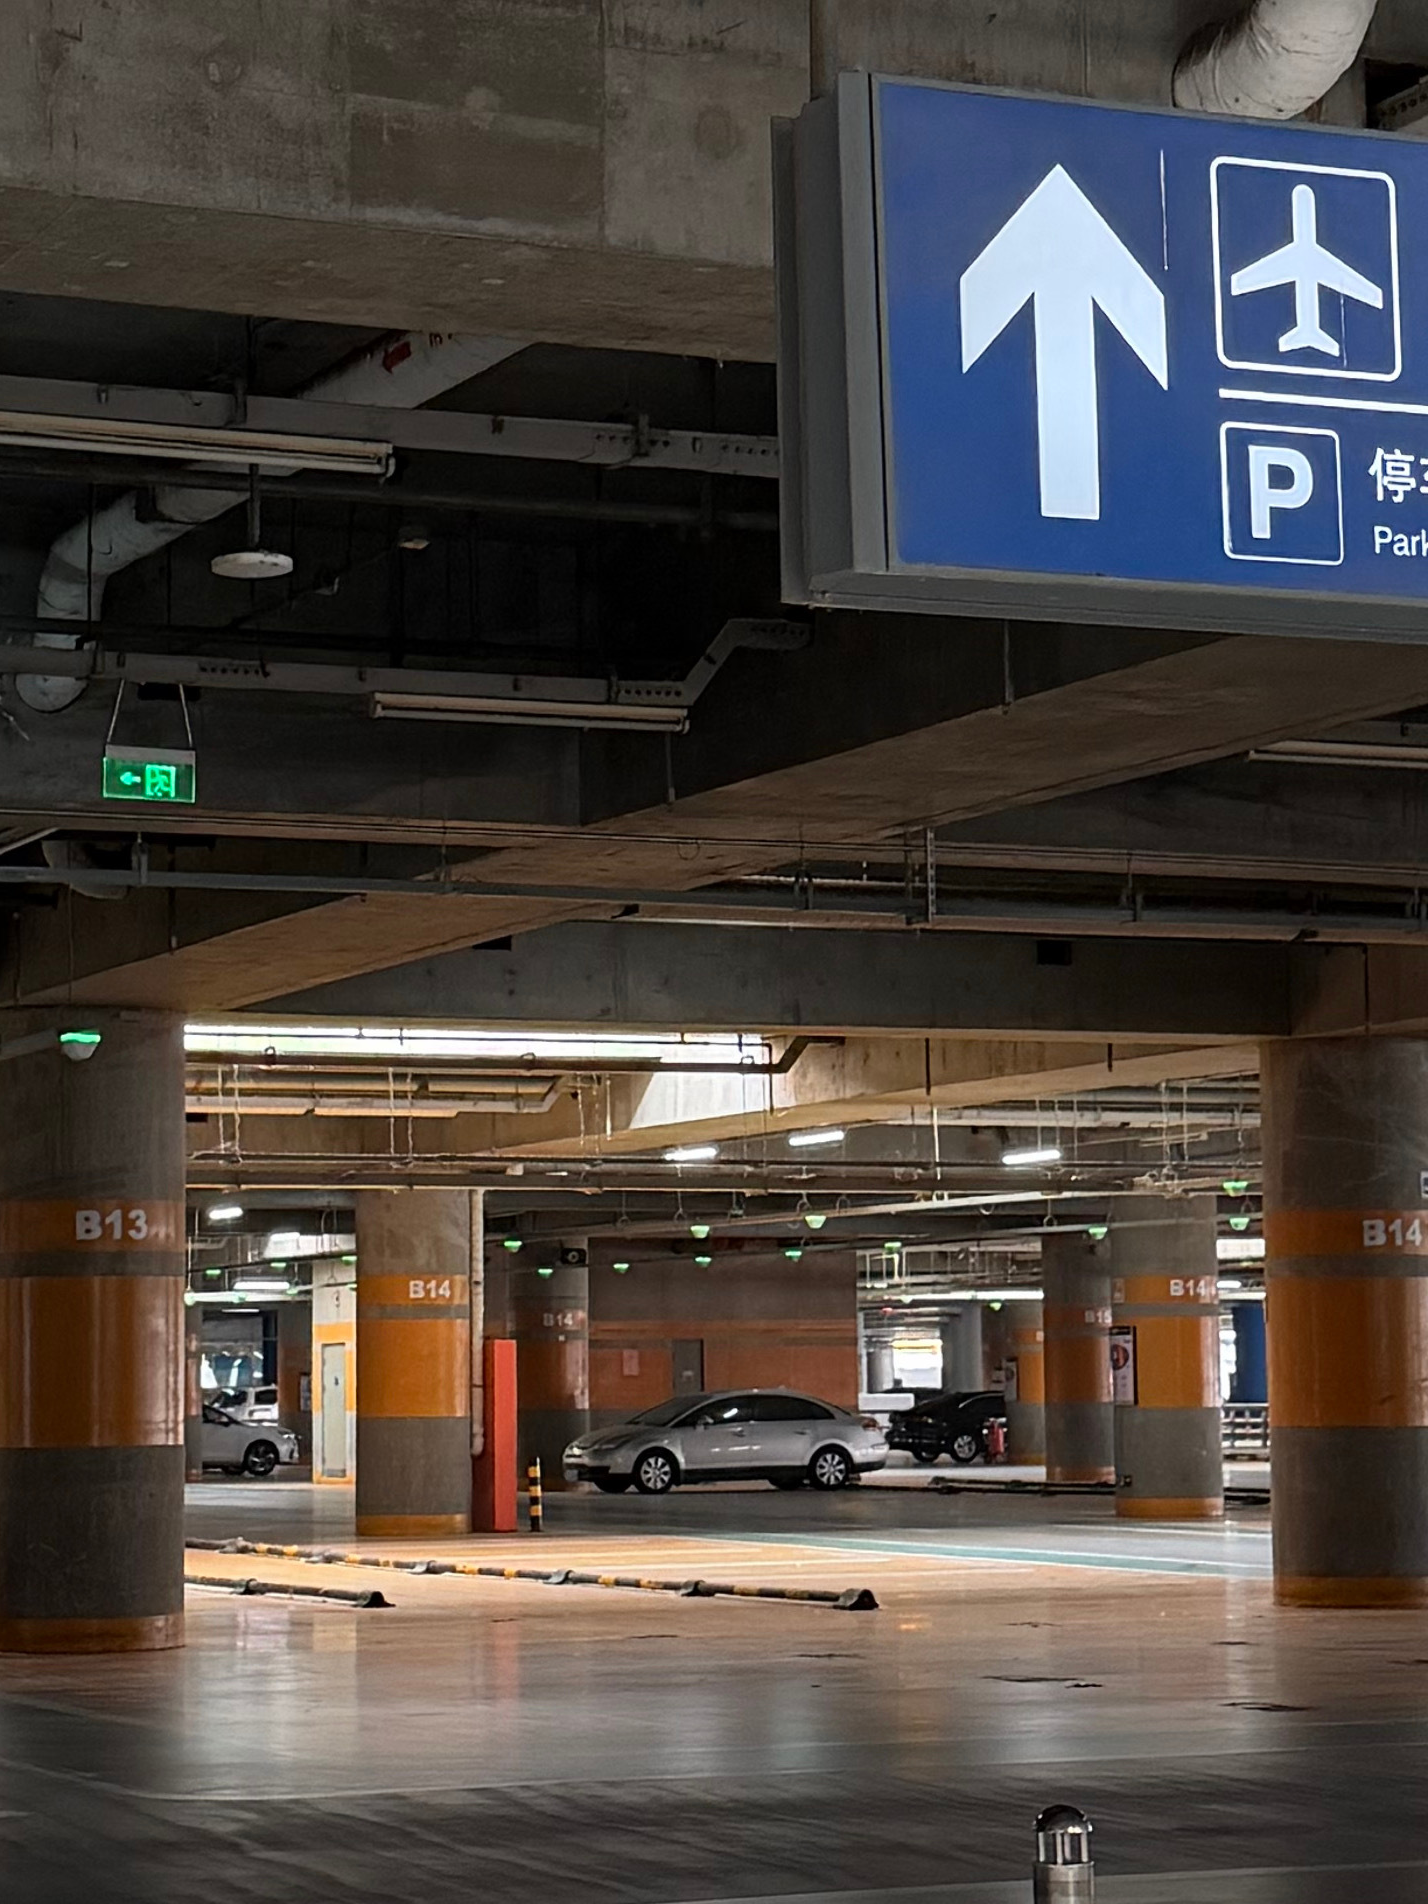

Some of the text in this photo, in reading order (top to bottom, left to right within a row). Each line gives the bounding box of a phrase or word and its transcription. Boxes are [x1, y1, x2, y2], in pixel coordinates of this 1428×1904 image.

[75, 1209, 148, 1241] B13
[1362, 1218, 1423, 1247] B14
[408, 1280, 451, 1299] B14
[1169, 1279, 1206, 1297] B14
[543, 1312, 574, 1327] B14
